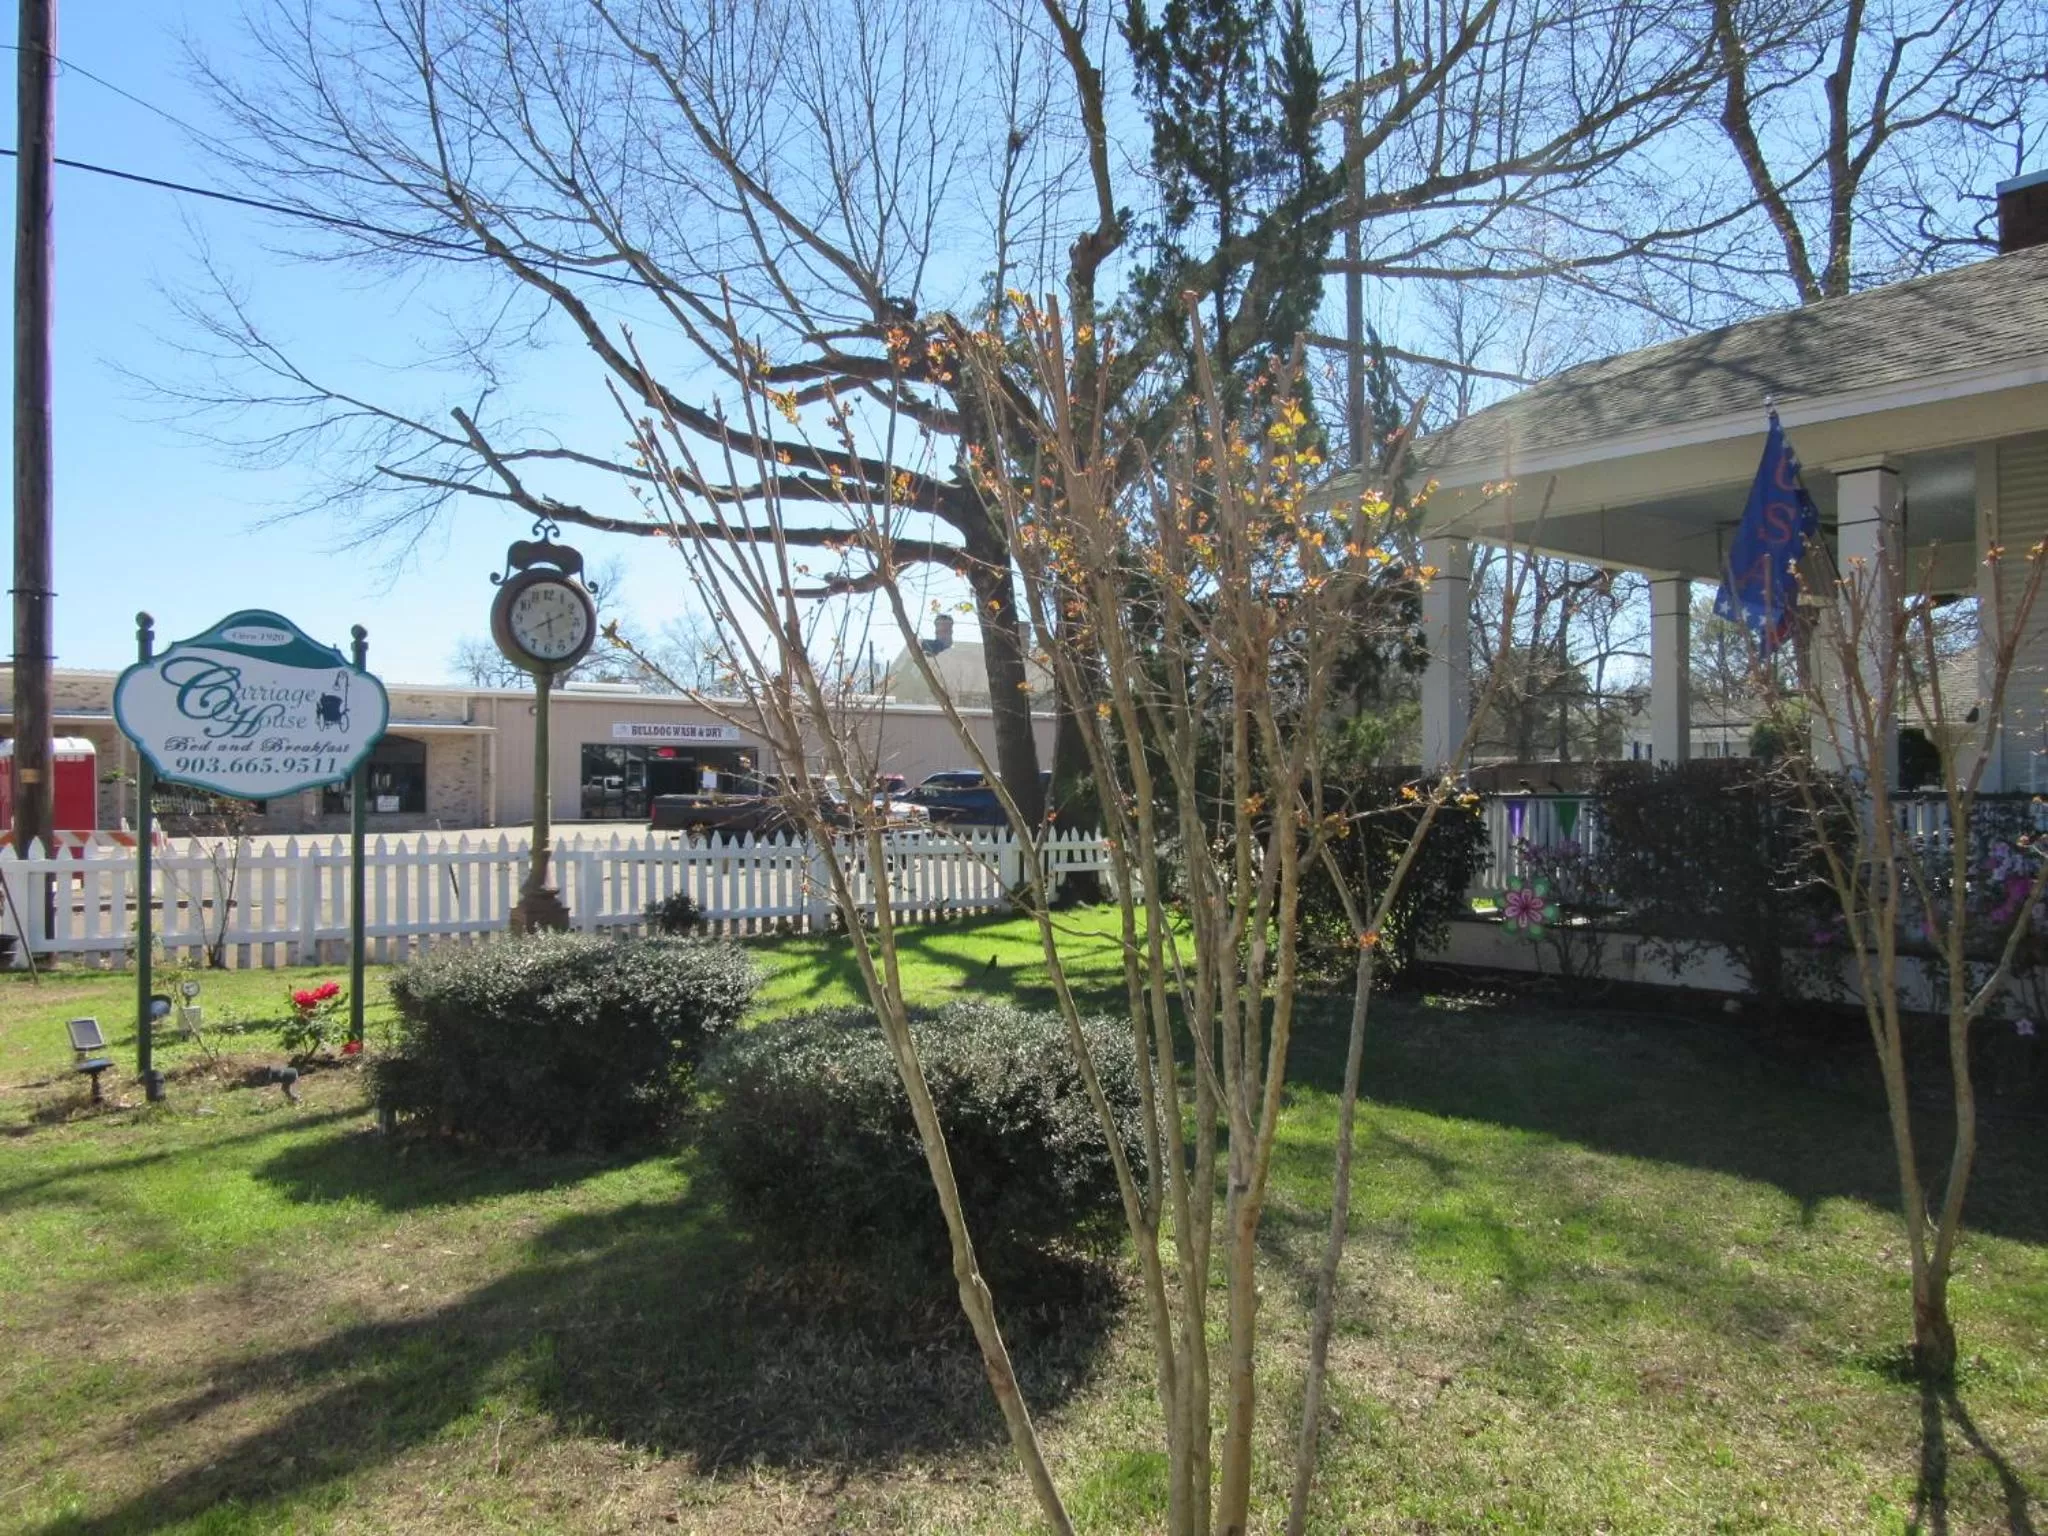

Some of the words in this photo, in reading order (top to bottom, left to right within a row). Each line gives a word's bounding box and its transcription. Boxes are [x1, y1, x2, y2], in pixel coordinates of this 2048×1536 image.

[260, 631, 286, 643] 1920
[160, 656, 317, 720] Carriage
[203, 703, 308, 738] House
[631, 725, 672, 737] BULLDOG
[673, 726, 697, 738] WASH
[697, 727, 704, 738] &
[705, 727, 722, 738] DRY
[164, 736, 212, 752] Bed
[218, 740, 254, 752] and
[261, 737, 350, 756] Breakfast
[175, 756, 337, 774] 903.665.9511
